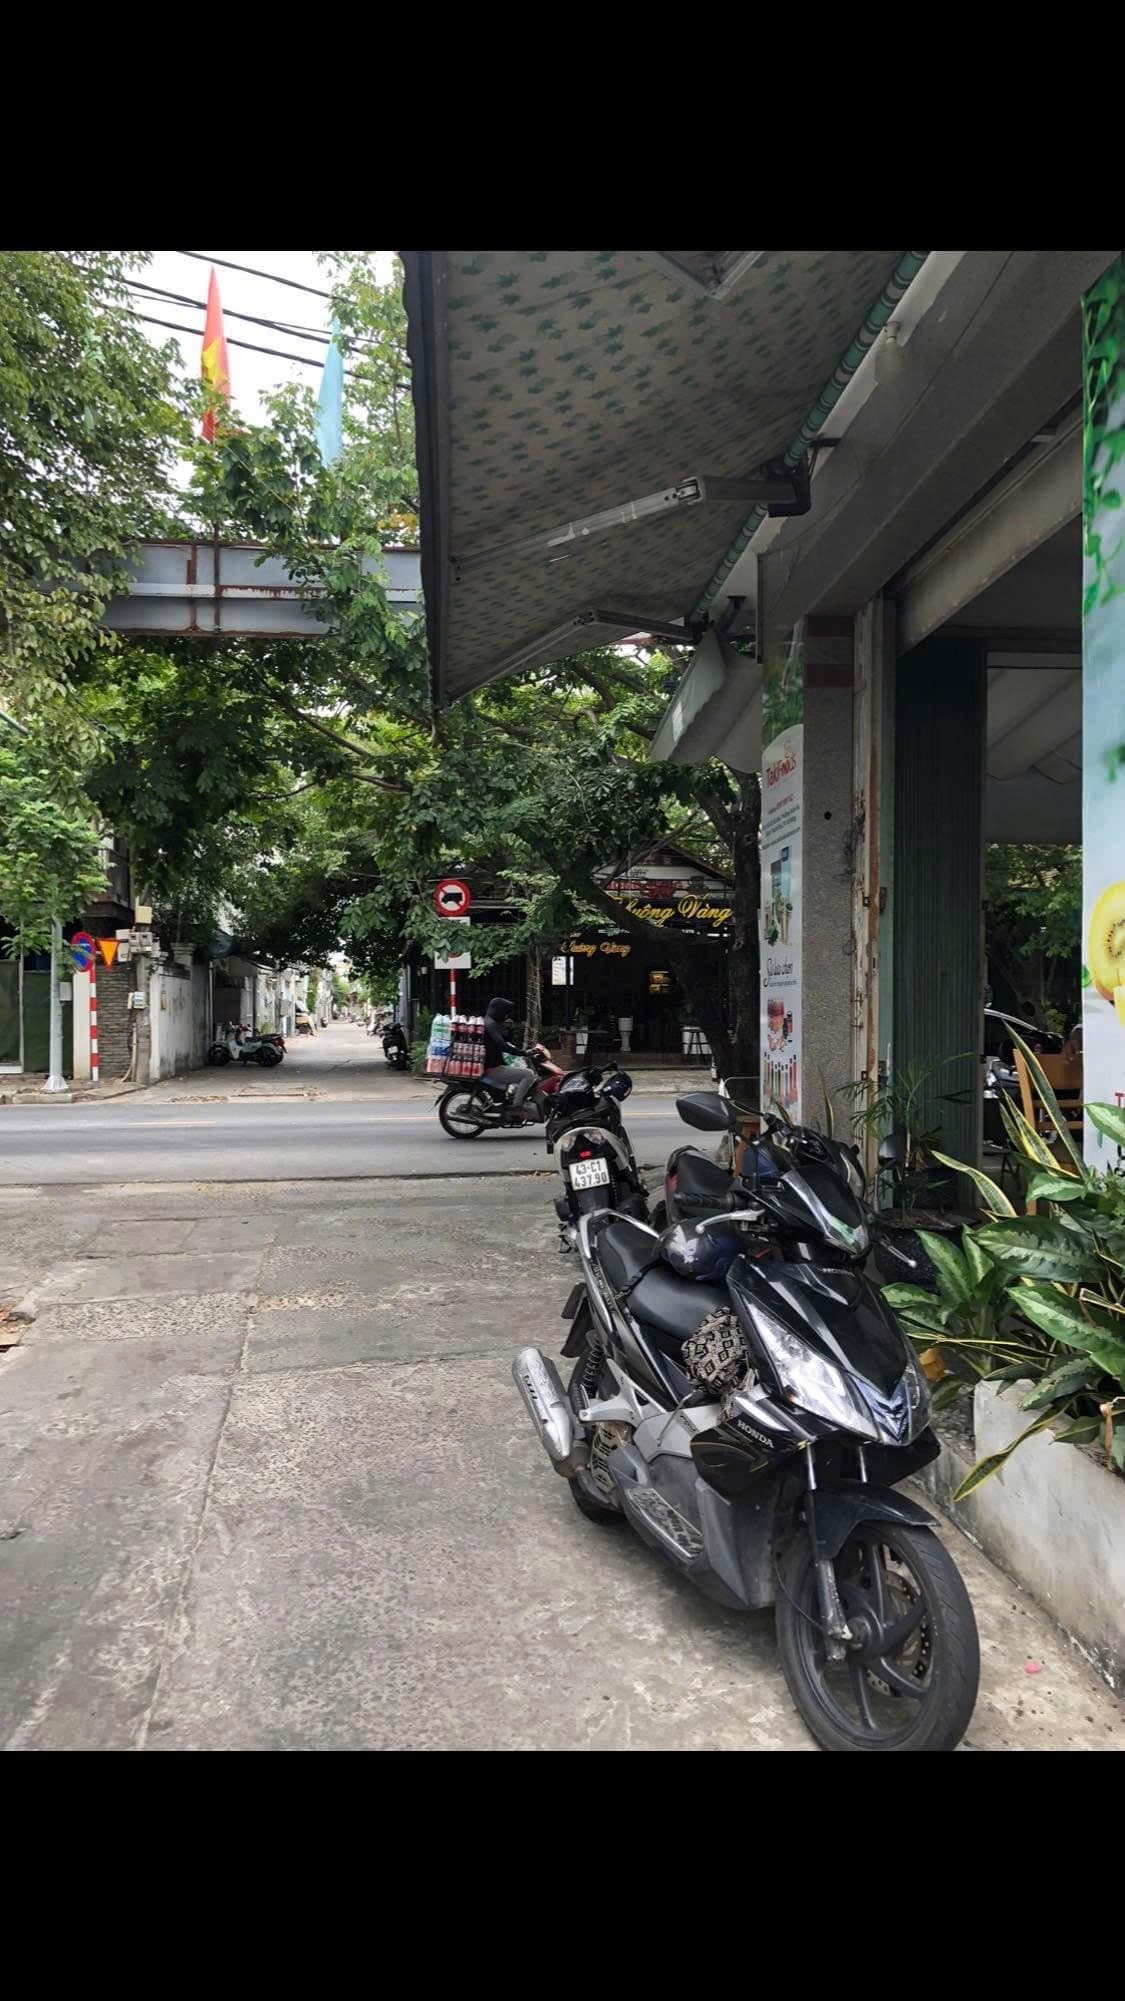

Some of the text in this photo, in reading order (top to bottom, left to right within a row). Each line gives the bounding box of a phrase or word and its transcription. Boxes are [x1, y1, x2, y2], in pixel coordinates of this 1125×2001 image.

[678, 893, 734, 928] Vàng
[575, 1172, 608, 1187] 437.90
[737, 1419, 774, 1449] HONDA
